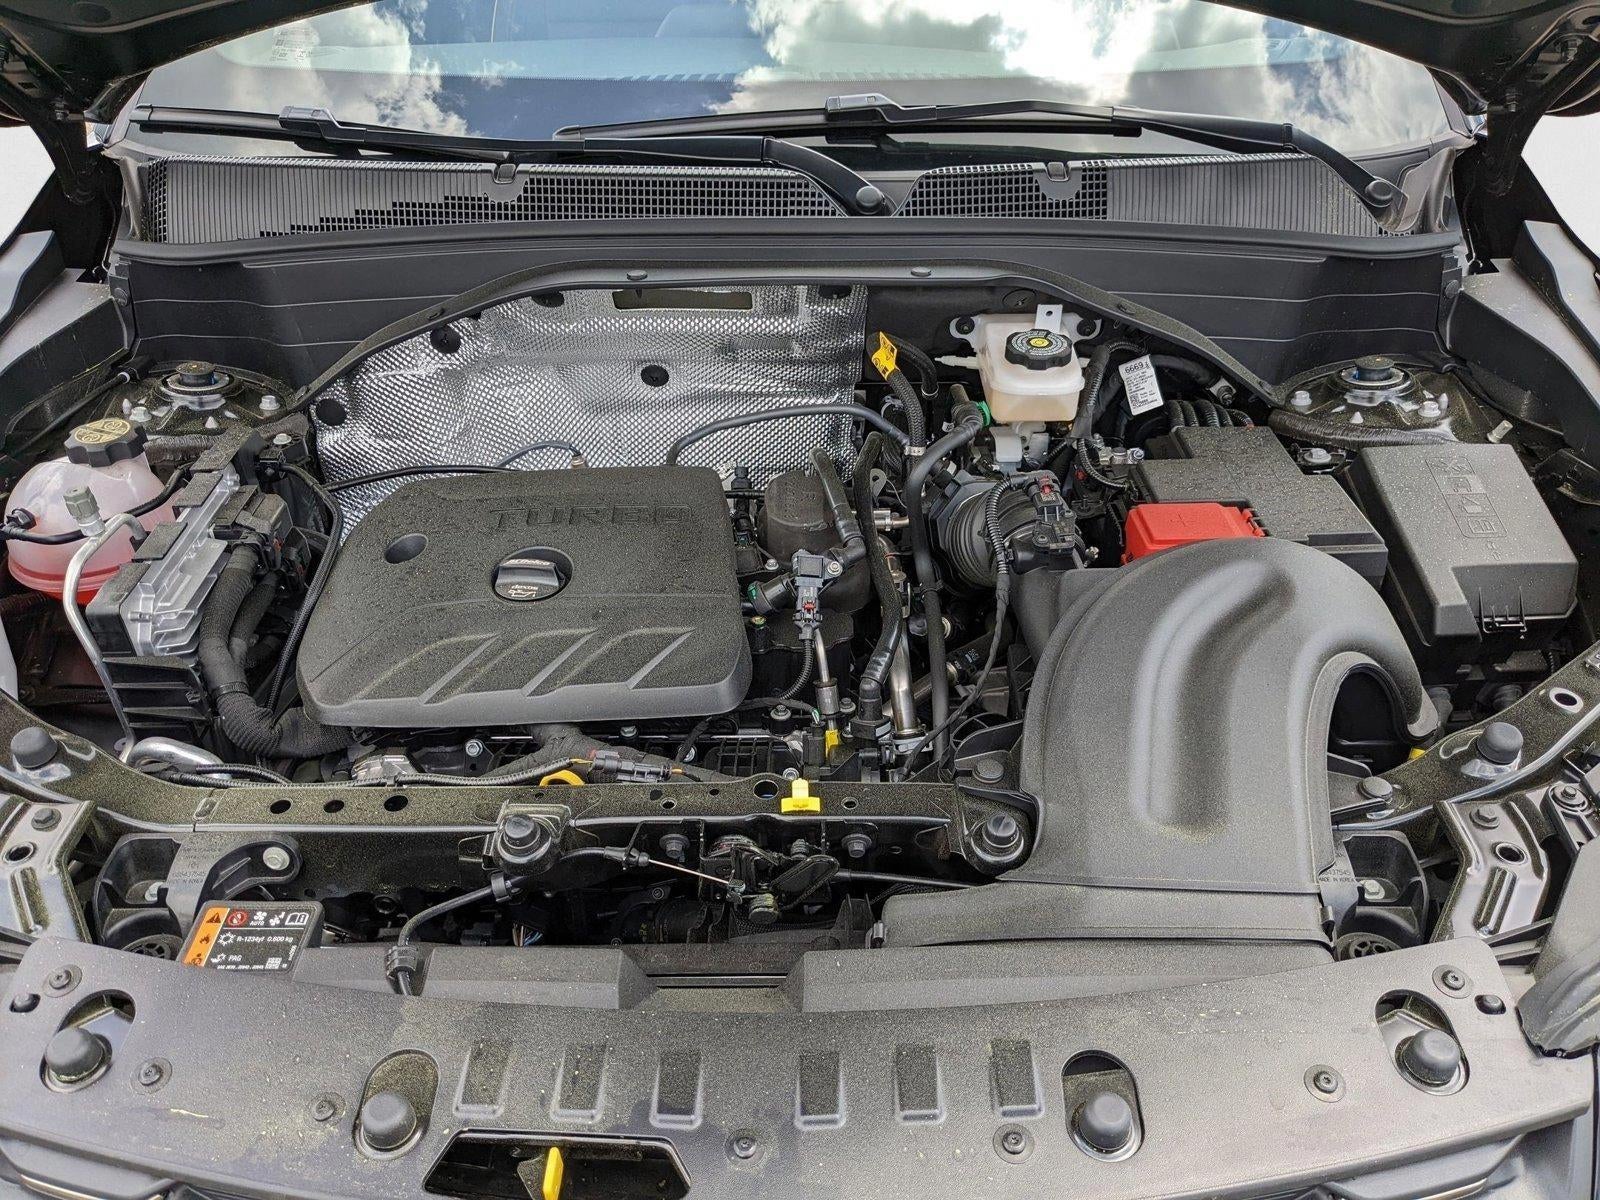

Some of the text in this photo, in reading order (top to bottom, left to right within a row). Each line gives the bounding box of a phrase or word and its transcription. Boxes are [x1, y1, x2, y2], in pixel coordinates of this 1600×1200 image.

[1125, 362, 1144, 373] 6669
[489, 505, 693, 527] TURBO
[228, 954, 243, 962] PAG
